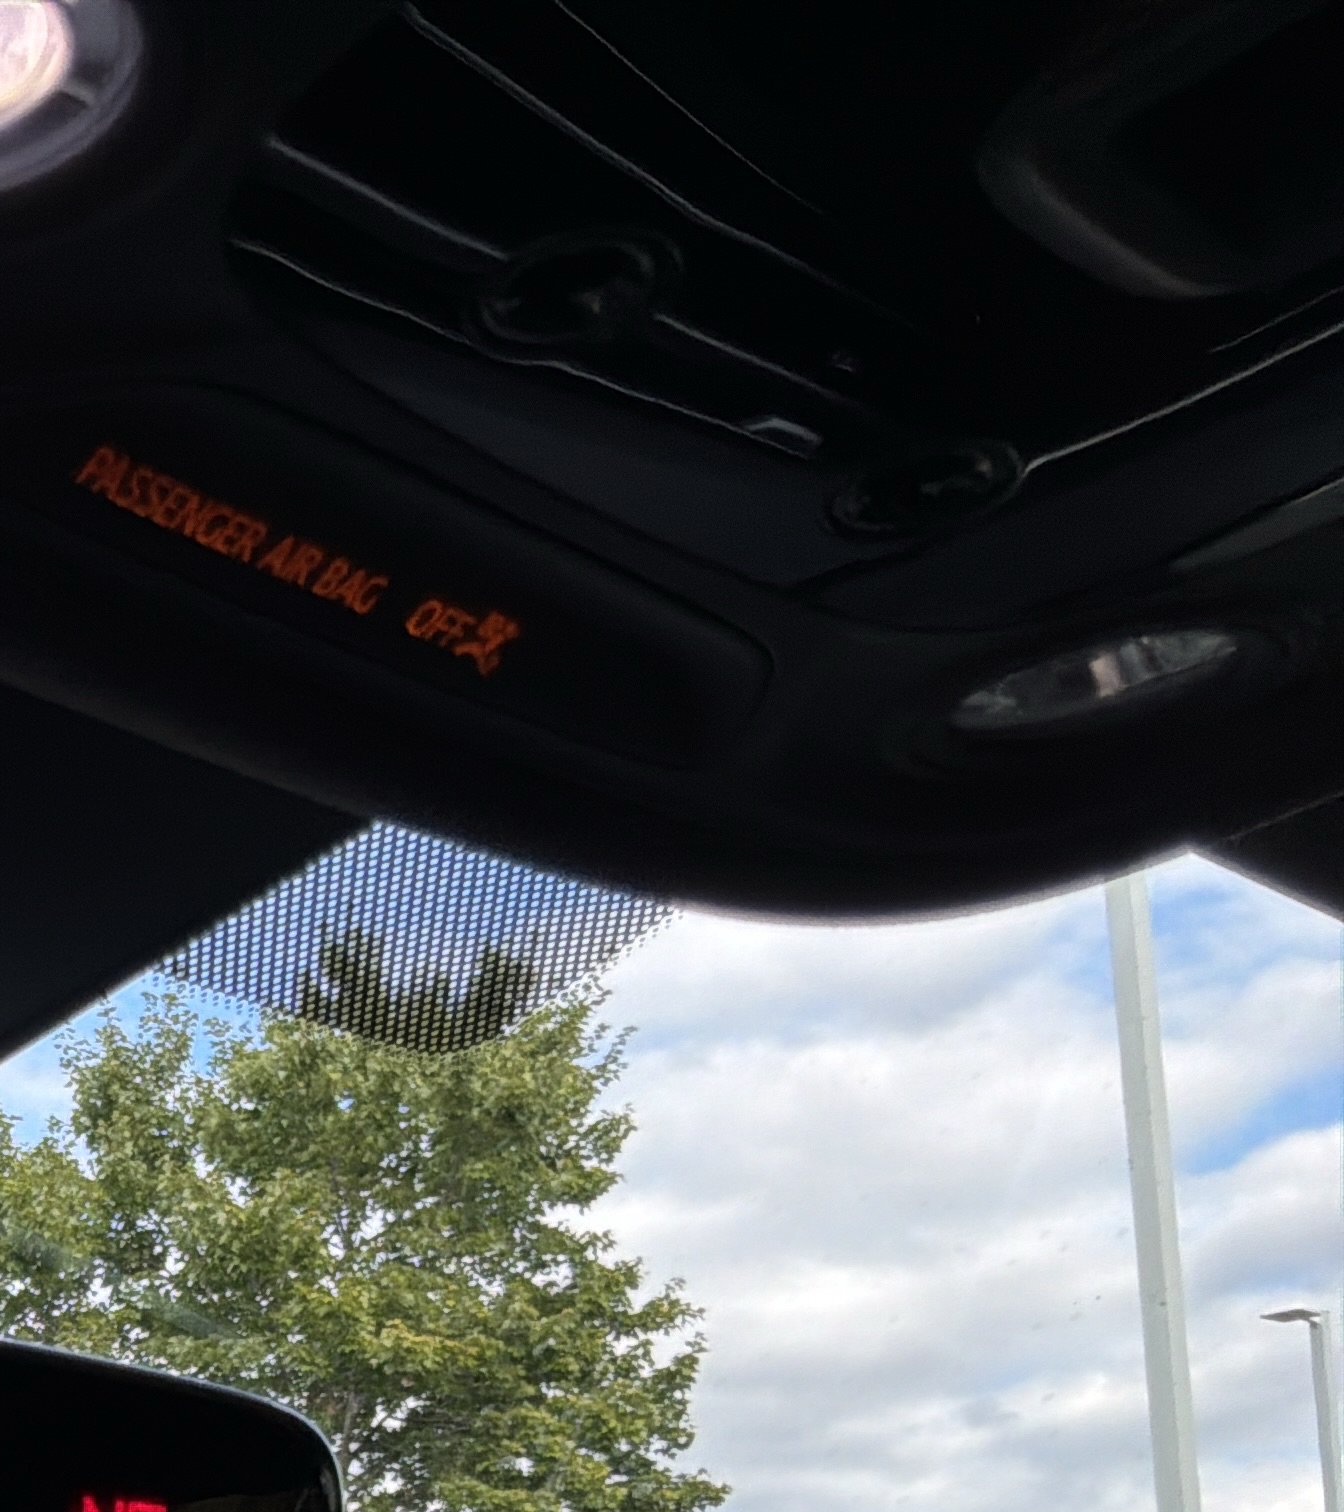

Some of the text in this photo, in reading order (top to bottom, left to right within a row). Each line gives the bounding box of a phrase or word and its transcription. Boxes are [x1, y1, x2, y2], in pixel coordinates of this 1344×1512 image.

[75, 444, 478, 648] PASSENGER AIR BAG OFF
